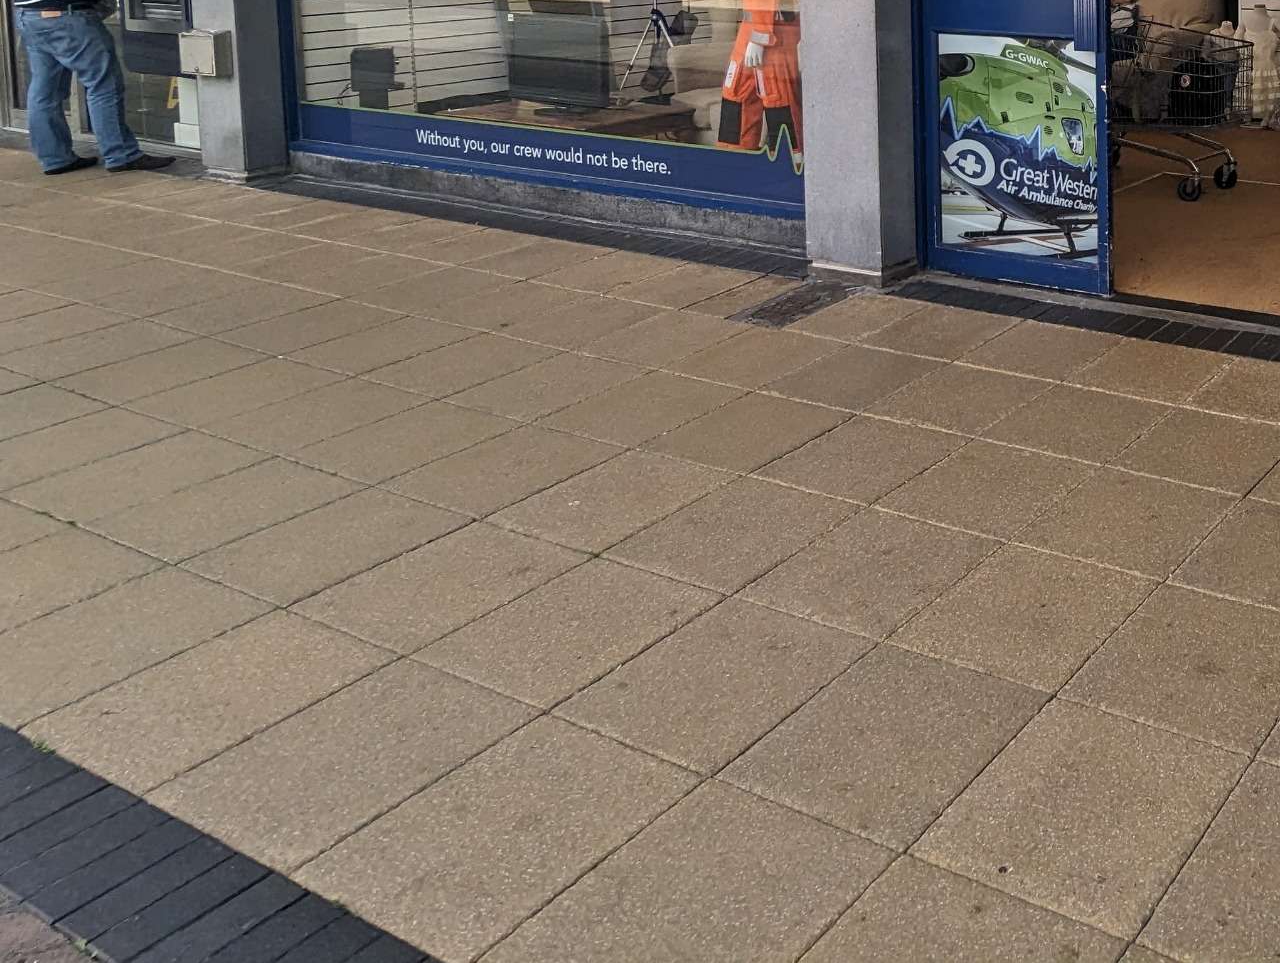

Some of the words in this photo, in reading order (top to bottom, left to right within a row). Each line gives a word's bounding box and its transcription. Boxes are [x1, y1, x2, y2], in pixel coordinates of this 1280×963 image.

[1005, 49, 1049, 68] G-GWAC
[415, 128, 461, 148] Without
[463, 138, 488, 154] you,
[490, 142, 511, 155] our
[514, 145, 542, 159] crew
[545, 148, 583, 165] would
[586, 153, 608, 168] not
[611, 154, 629, 170] be
[632, 155, 672, 175] there.
[1000, 158, 1049, 188] Great
[997, 180, 1018, 197] Air
[1019, 186, 1073, 209] Ambulance
[1073, 199, 1098, 214] Charity
